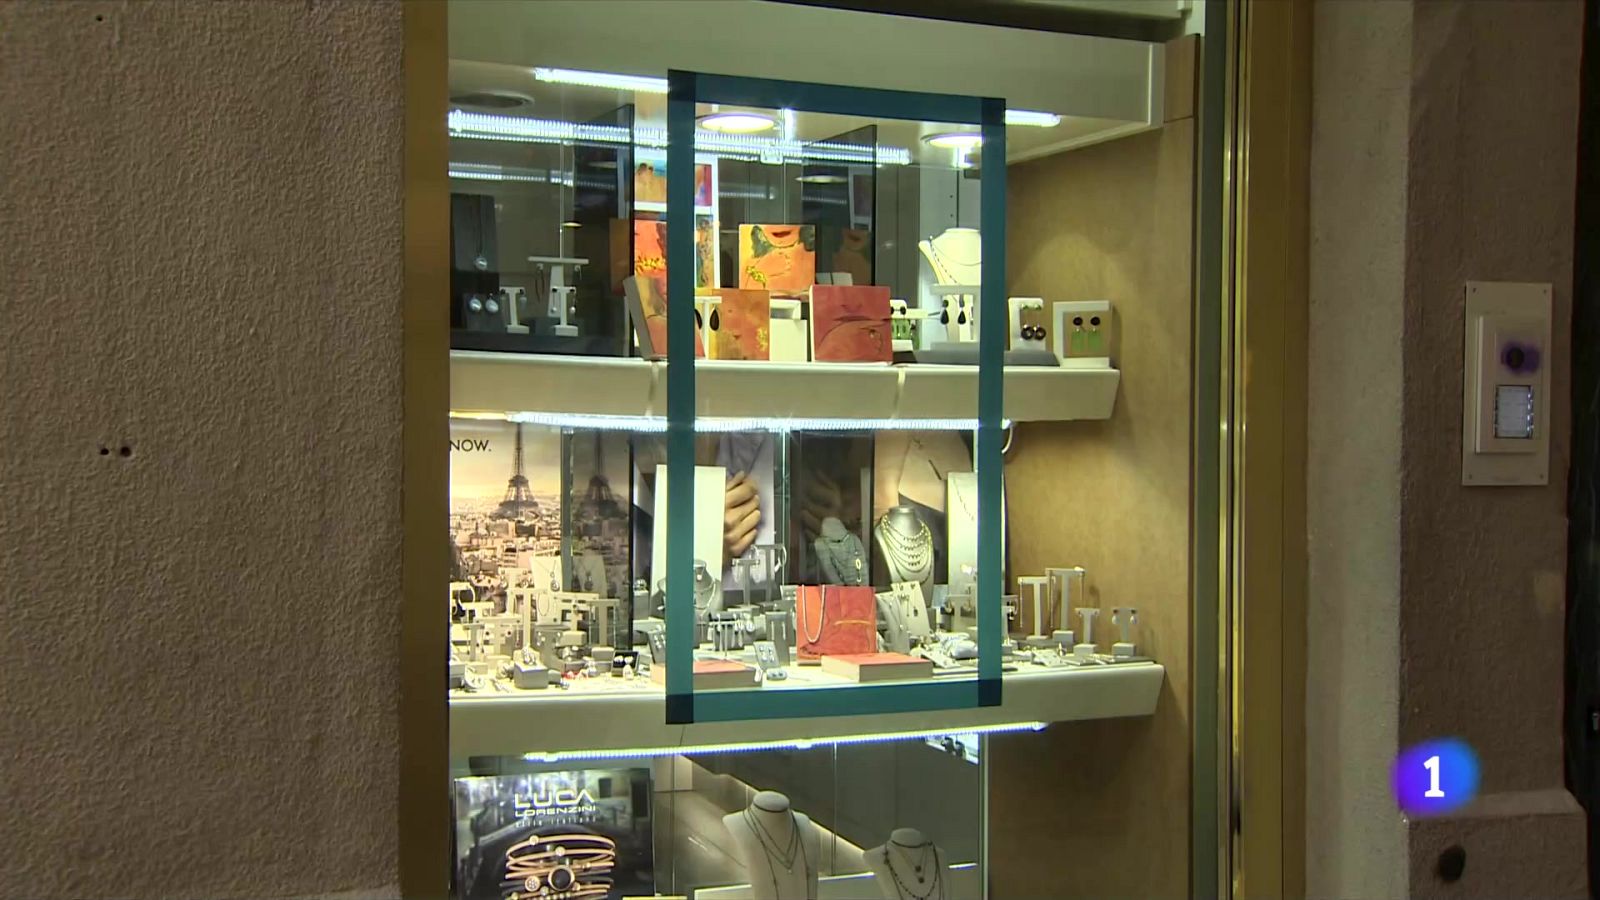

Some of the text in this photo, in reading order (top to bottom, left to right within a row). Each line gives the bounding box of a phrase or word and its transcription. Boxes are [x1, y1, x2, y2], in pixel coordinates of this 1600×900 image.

[449, 439, 492, 452] NOW.
[514, 788, 595, 809] LUCA
[514, 804, 597, 818] LORENZINI
